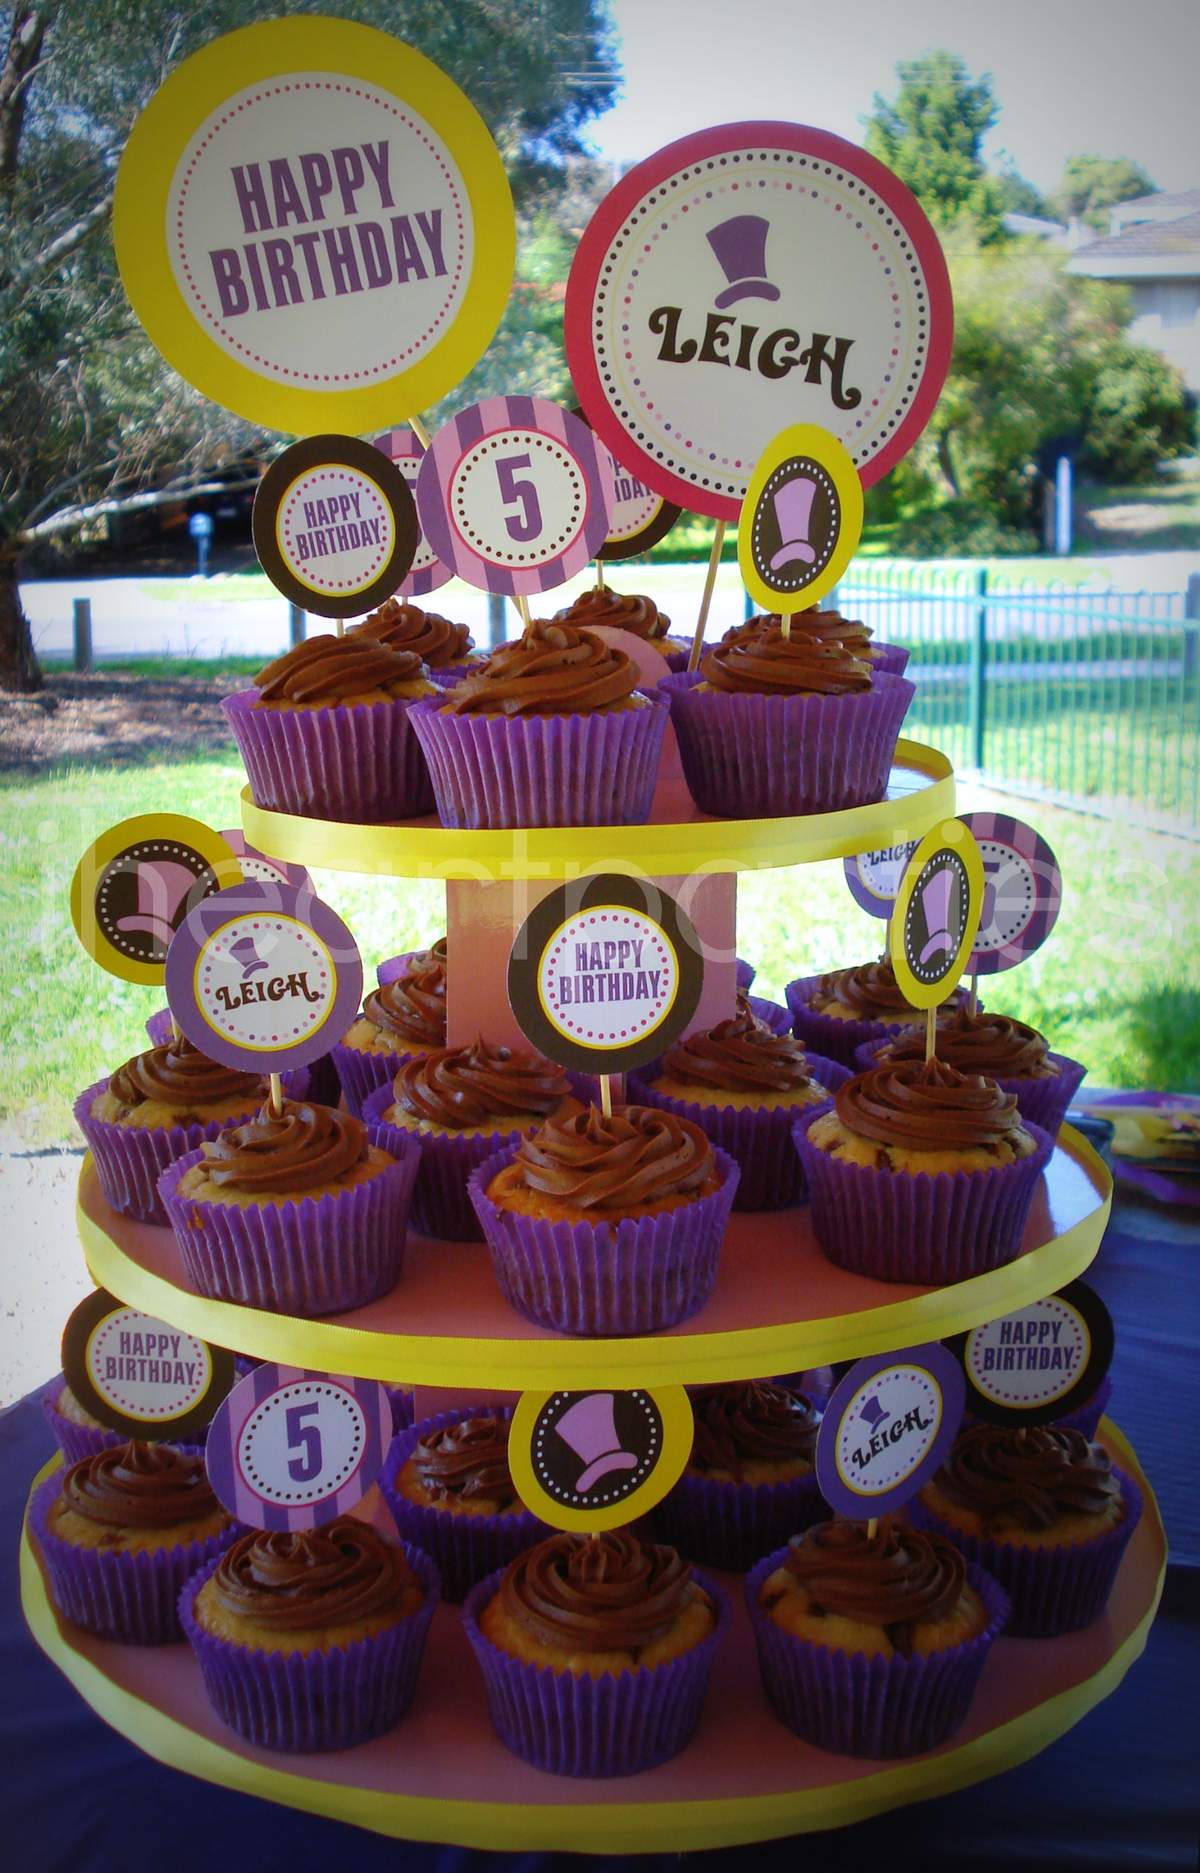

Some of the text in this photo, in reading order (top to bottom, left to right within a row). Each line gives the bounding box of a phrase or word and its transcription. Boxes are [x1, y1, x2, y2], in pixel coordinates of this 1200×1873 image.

[231, 140, 396, 234] HAPPY
[208, 209, 449, 318] BIRTHDAY
[648, 306, 862, 410] LEIGH
[303, 491, 361, 528] HAPPY
[494, 453, 543, 542] 5
[295, 518, 381, 560] BIRTHDAY
[575, 940, 643, 971] HAPPY
[215, 972, 320, 1010] LEIGH
[559, 970, 661, 1005] BIRTHDAY
[119, 1331, 181, 1358] HAPPY
[1000, 1321, 1063, 1346] HAPPY
[105, 1356, 196, 1386] BIRTHDAY
[983, 1347, 1075, 1371] BIRTHDAY
[285, 1401, 323, 1482] 5
[851, 1407, 934, 1469] LEIGH
